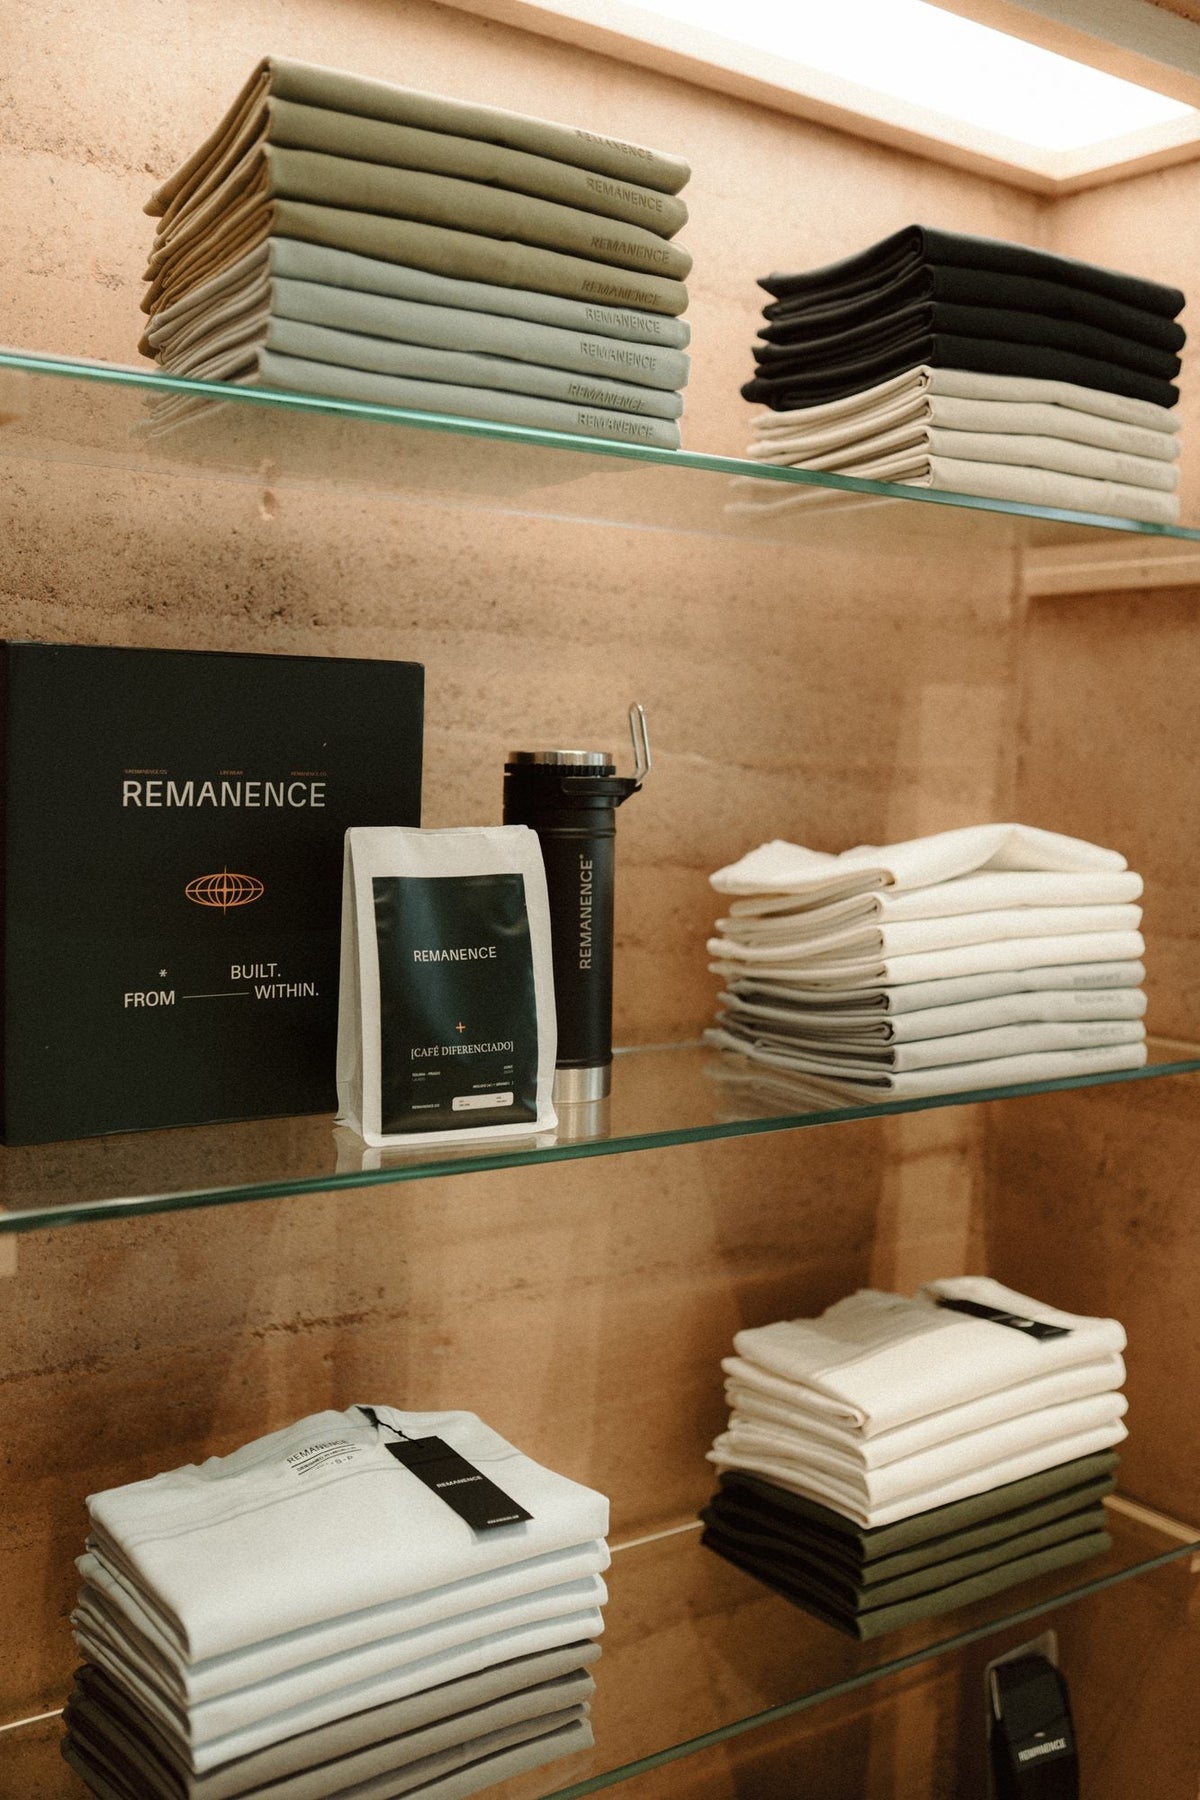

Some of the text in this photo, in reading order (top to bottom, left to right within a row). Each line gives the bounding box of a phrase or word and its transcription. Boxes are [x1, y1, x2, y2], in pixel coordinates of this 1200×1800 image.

[586, 176, 663, 212] REMANENCE
[590, 236, 670, 264] REMANENCE
[584, 307, 661, 333] REMANENCE
[580, 342, 657, 370] REMANENCE
[567, 383, 646, 411] REMANENCE
[577, 413, 655, 437] REMANENCE
[122, 780, 326, 807] REMANENCE
[413, 946, 497, 962] REMANENCE
[230, 963, 281, 980] BUILT.
[124, 982, 320, 1008] FROM WITHIN.
[411, 1041, 514, 1060] [CAFÉ DIFERENCIADO]
[286, 1440, 350, 1464] REMANENCE
[436, 1475, 483, 1488] REMANENCE
